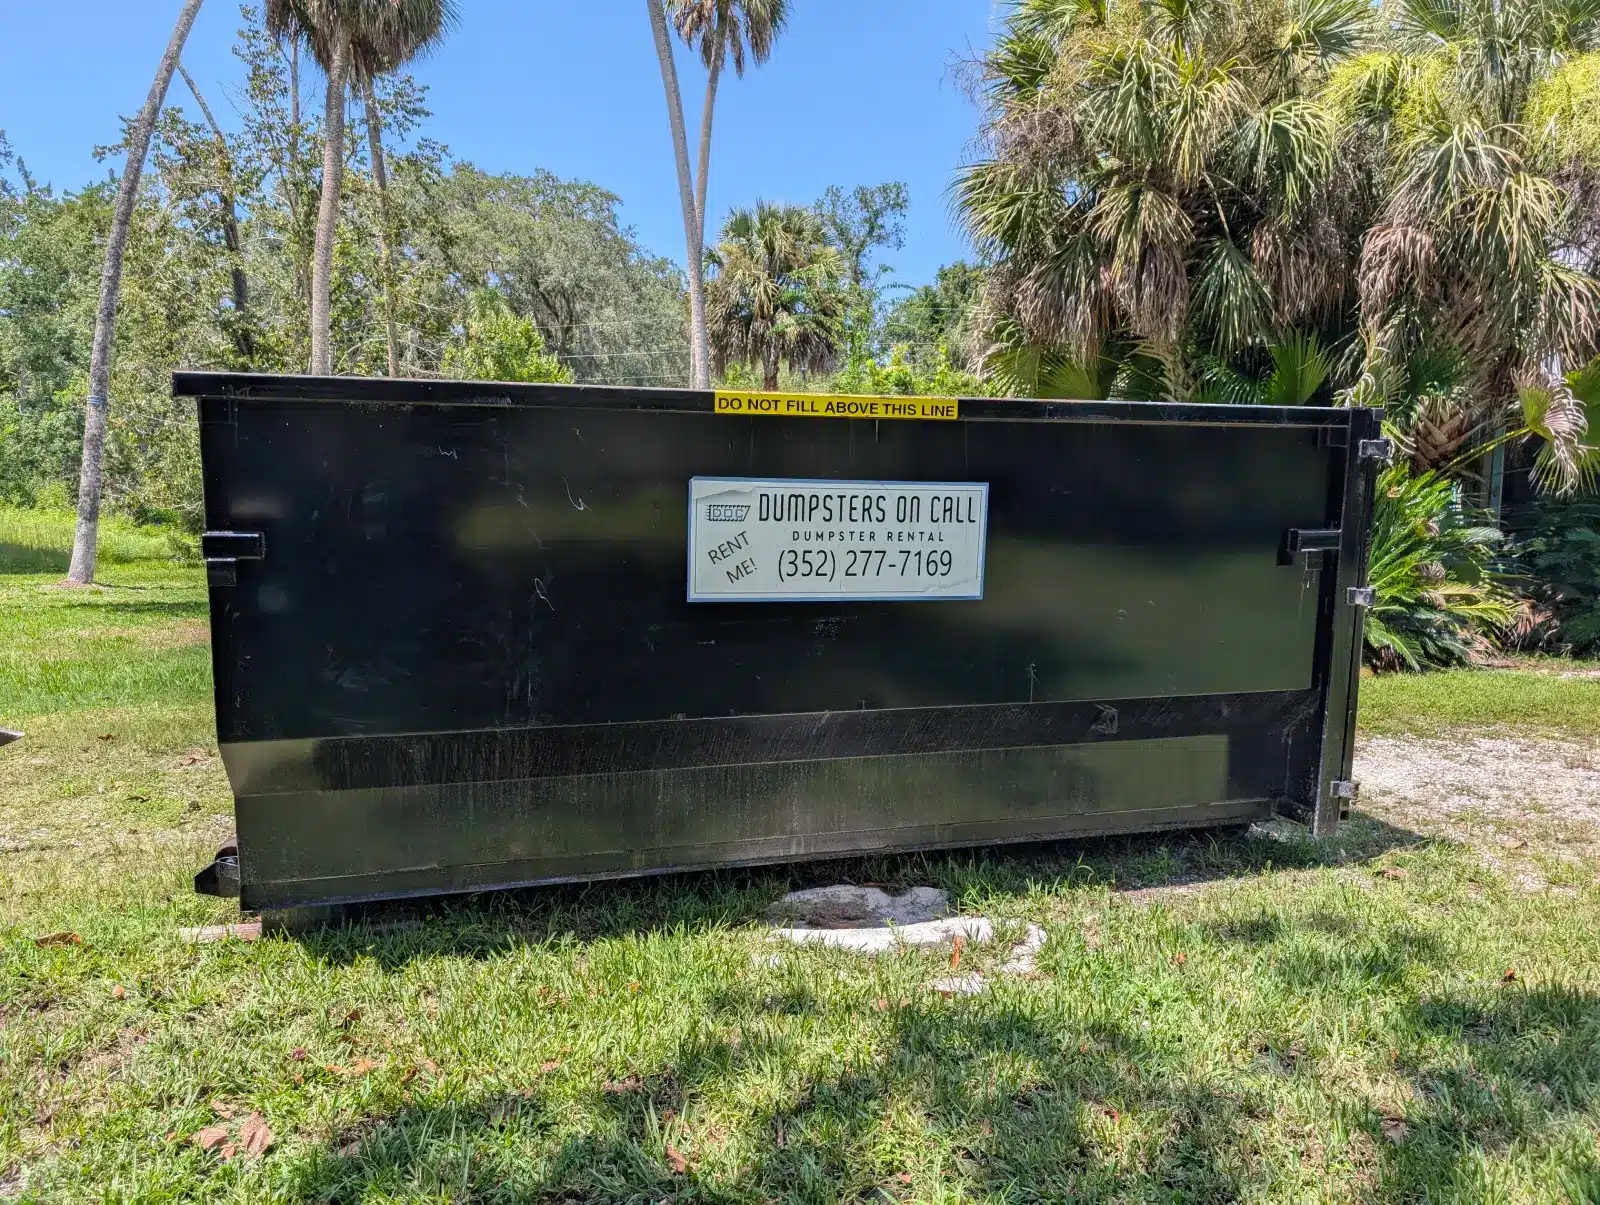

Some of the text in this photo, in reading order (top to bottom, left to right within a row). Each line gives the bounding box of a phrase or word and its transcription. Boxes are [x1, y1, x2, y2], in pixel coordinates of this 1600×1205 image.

[718, 398, 955, 417] DO NOT FILL ABOVE THIS LINE
[759, 493, 976, 524] DUMPSTERS ON CALL
[708, 530, 751, 565] RENT
[792, 531, 944, 542] DUMPSTER RENTAL
[725, 557, 758, 584] ME!
[778, 549, 952, 582] (352) 277-7169
